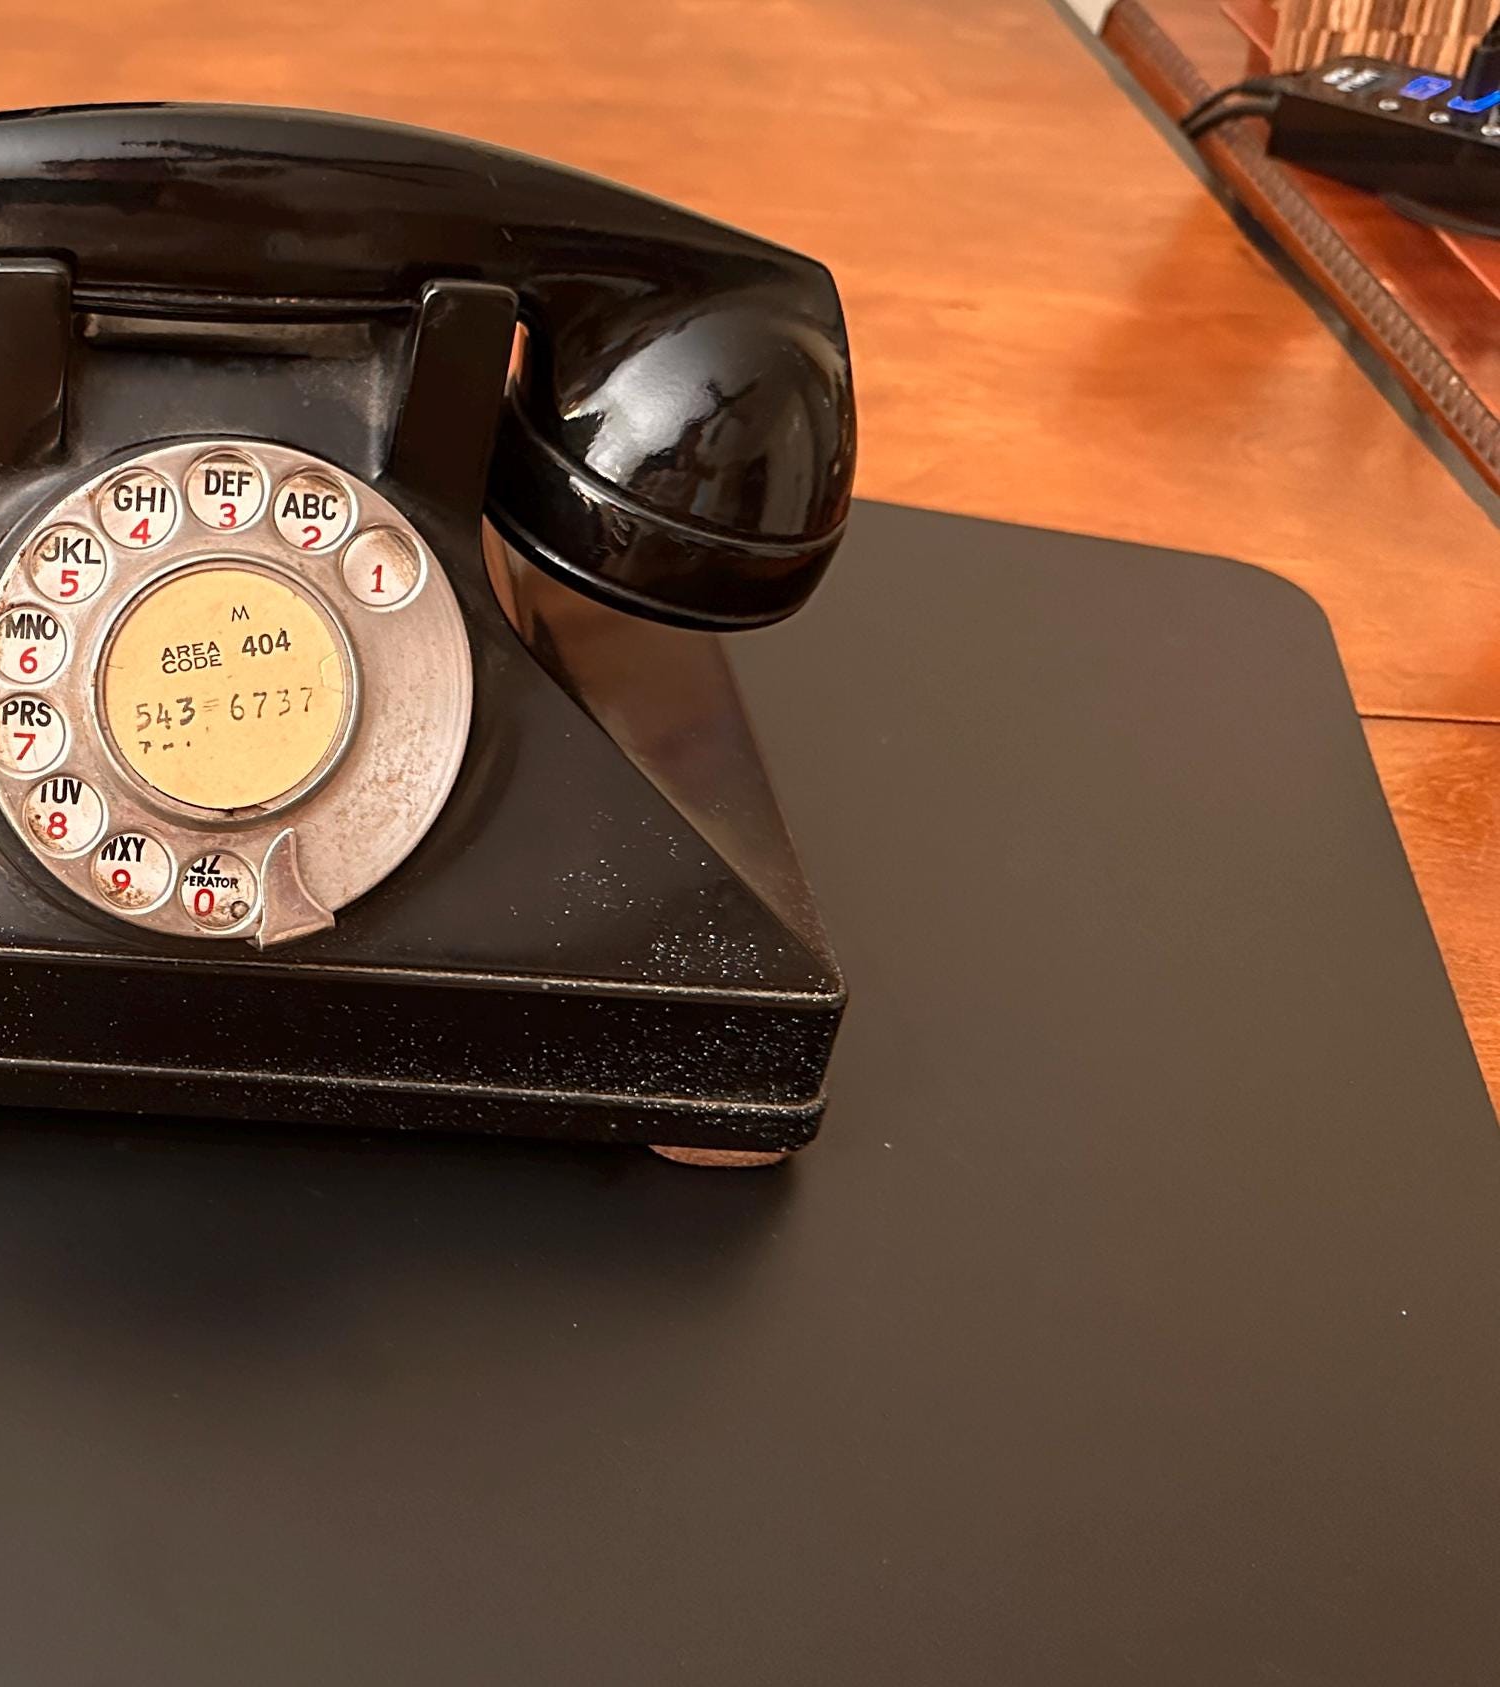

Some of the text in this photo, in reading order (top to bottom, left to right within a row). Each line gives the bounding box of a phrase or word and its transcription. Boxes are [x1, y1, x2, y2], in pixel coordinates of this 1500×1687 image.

[204, 470, 252, 497] DEF
[114, 484, 167, 513] GHI
[282, 493, 338, 521] ABC
[219, 503, 237, 528] 3
[130, 518, 152, 544] 4
[301, 526, 322, 549] 2
[39, 537, 102, 565] JKL
[59, 569, 80, 597] 5
[371, 565, 385, 593] 1
[5, 613, 59, 640] MNO
[161, 641, 220, 661] AREA
[242, 629, 292, 657] 404
[19, 647, 38, 674] 6
[162, 654, 222, 674] CODE
[2, 700, 52, 727] PRS
[13, 733, 36, 761] 7
[40, 778, 82, 805] TUV
[47, 811, 68, 839] 8
[112, 869, 131, 891] 9
[183, 875, 239, 889] PERATOR
